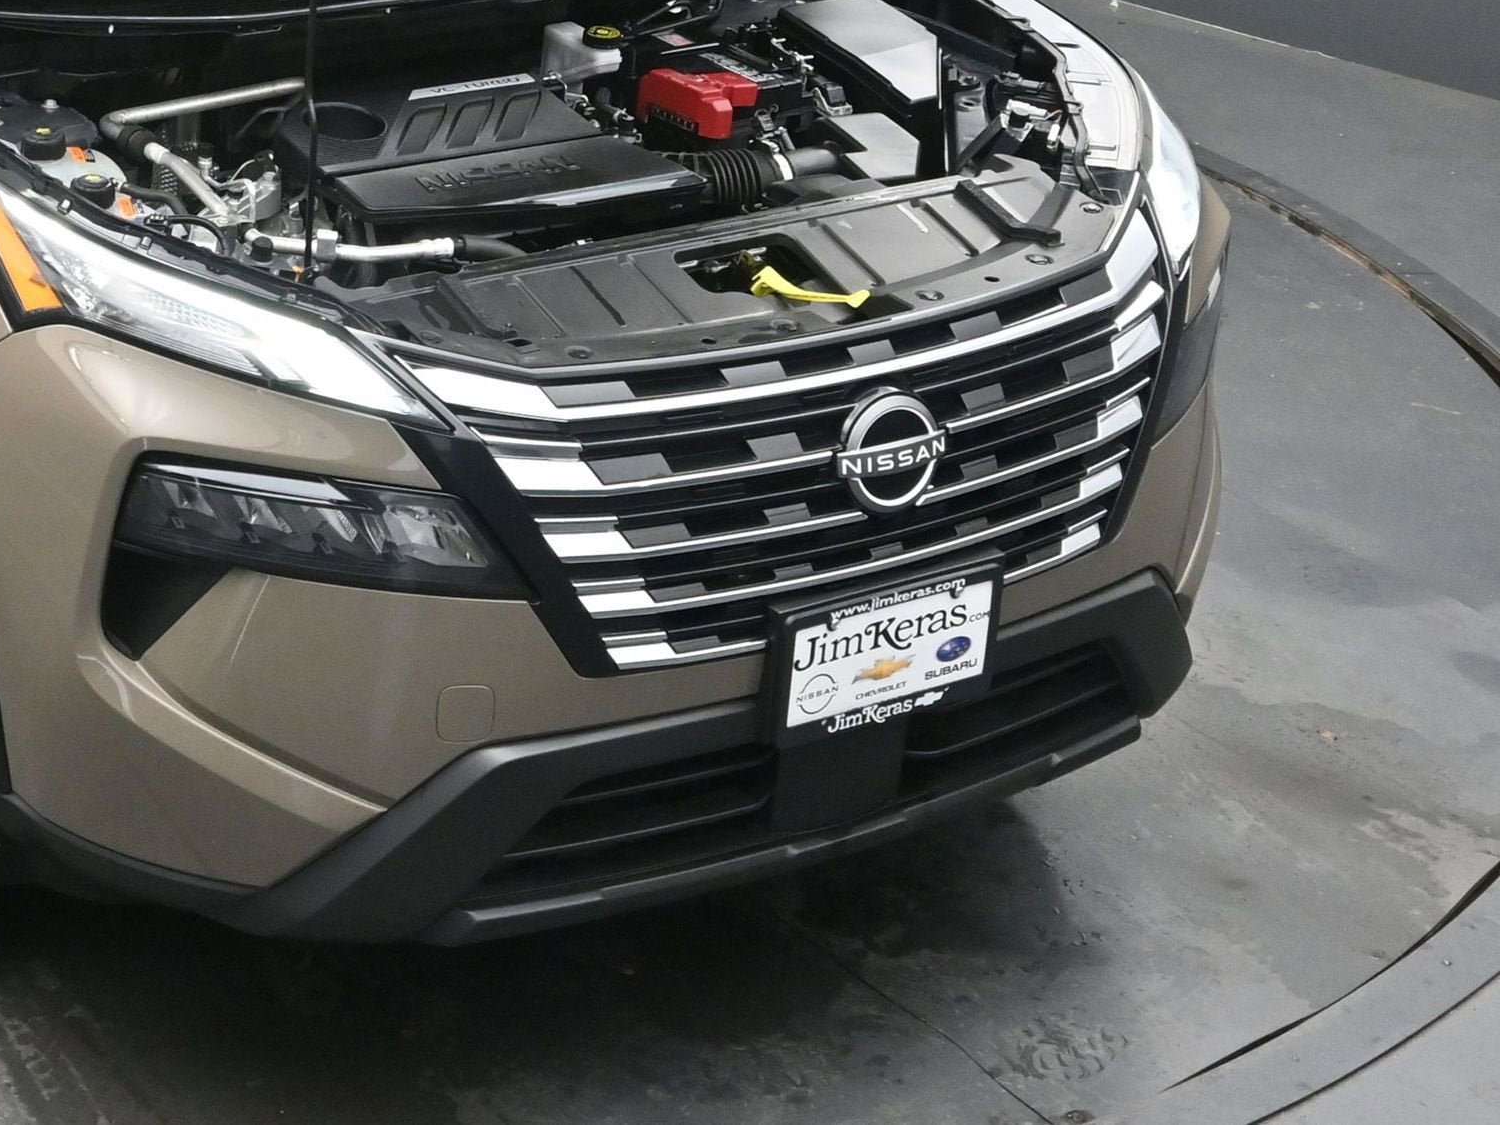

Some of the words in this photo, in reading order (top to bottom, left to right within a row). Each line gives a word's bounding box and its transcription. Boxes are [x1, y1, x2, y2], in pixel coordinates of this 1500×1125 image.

[841, 436, 946, 476] NISSAN
[830, 577, 966, 620] www.jimkeras.com
[924, 657, 978, 681] SUBARU
[796, 684, 840, 704] NISSAN
[855, 681, 907, 701] CHEVROLET
